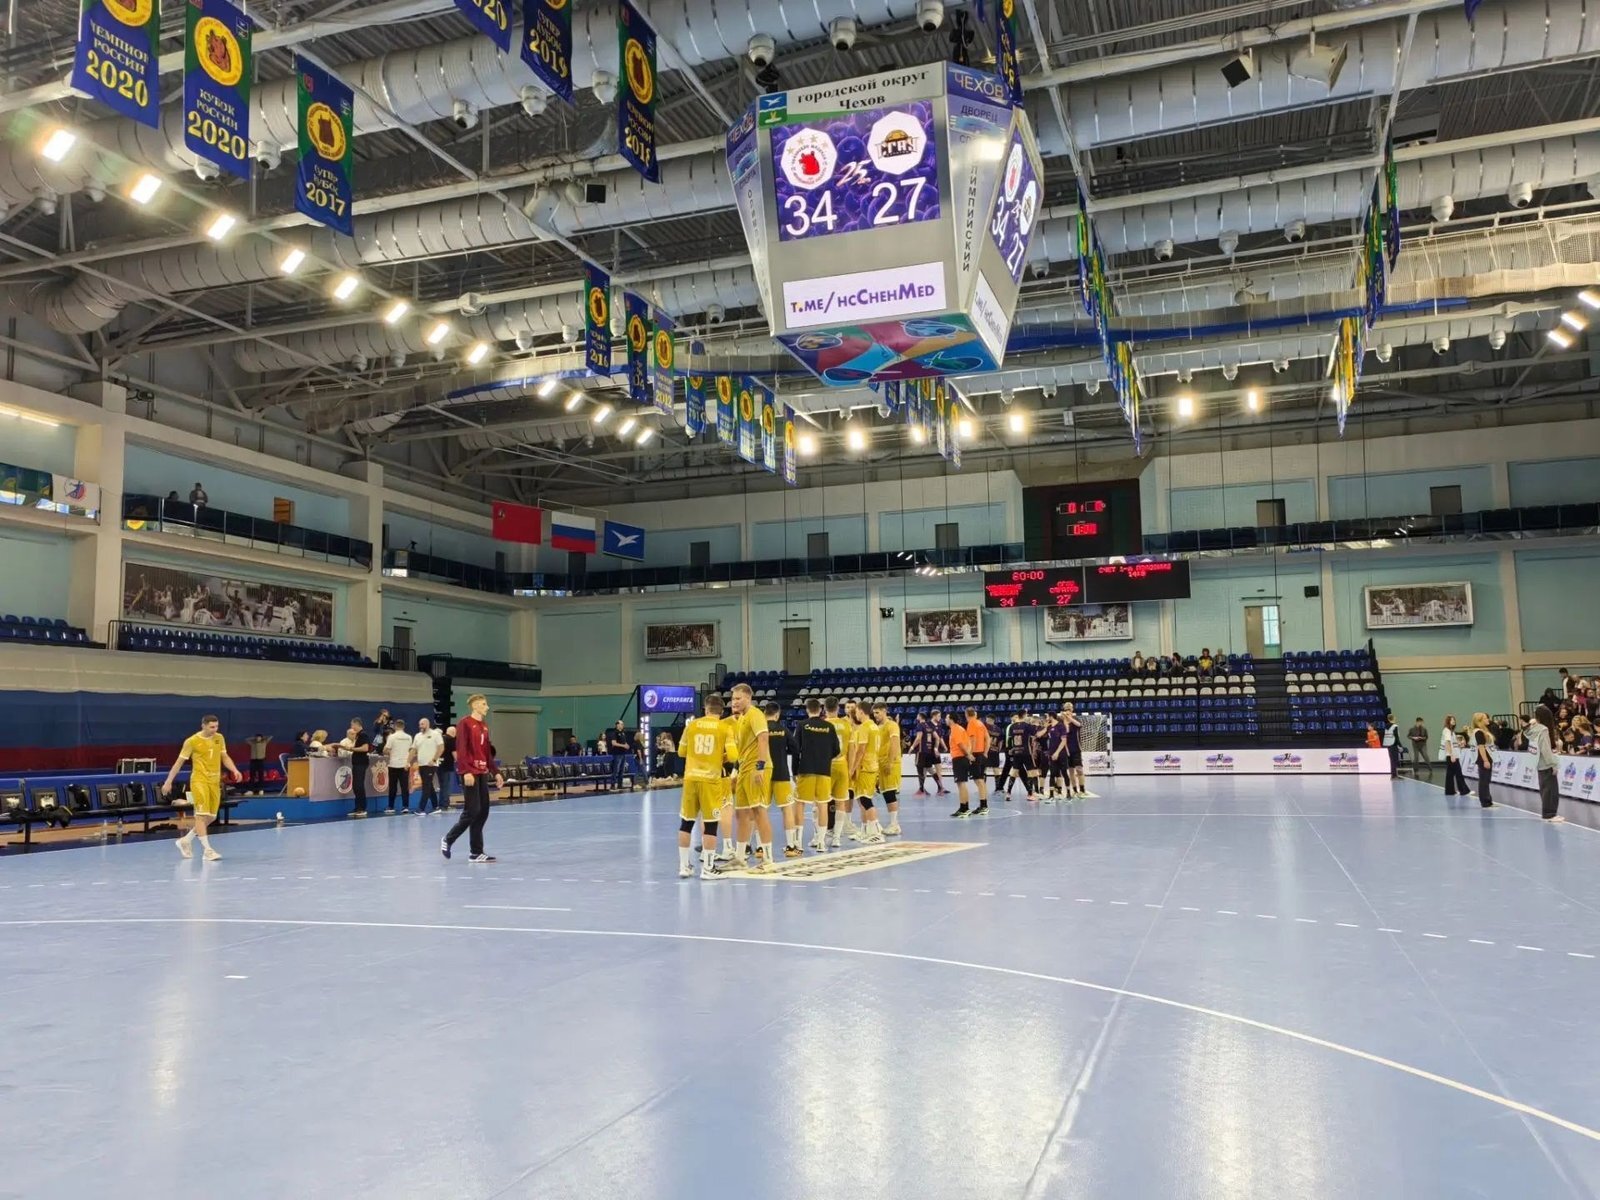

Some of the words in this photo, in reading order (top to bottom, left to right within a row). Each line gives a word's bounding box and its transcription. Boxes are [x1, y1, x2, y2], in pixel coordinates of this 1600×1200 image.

[94, 37, 145, 75] РОССИИ
[85, 49, 149, 107] 2020
[797, 79, 877, 103] городской
[881, 71, 929, 87] округ
[954, 72, 1005, 98] ЧЕХОВ
[196, 99, 238, 131] РОССИИ
[199, 88, 235, 116] КУБОК
[839, 95, 886, 110] Чехов
[961, 104, 999, 123] ДВОРЕЦ
[187, 110, 246, 160] 2020
[305, 182, 346, 216] 2017
[784, 190, 838, 236] 34
[871, 176, 926, 225] 27
[1006, 231, 1025, 276] 27
[1012, 570, 1044, 581] 60:00
[1000, 598, 1014, 607] 34
[1056, 594, 1071, 605] 27
[208, 748, 214, 759] 7
[694, 733, 715, 755] 89
